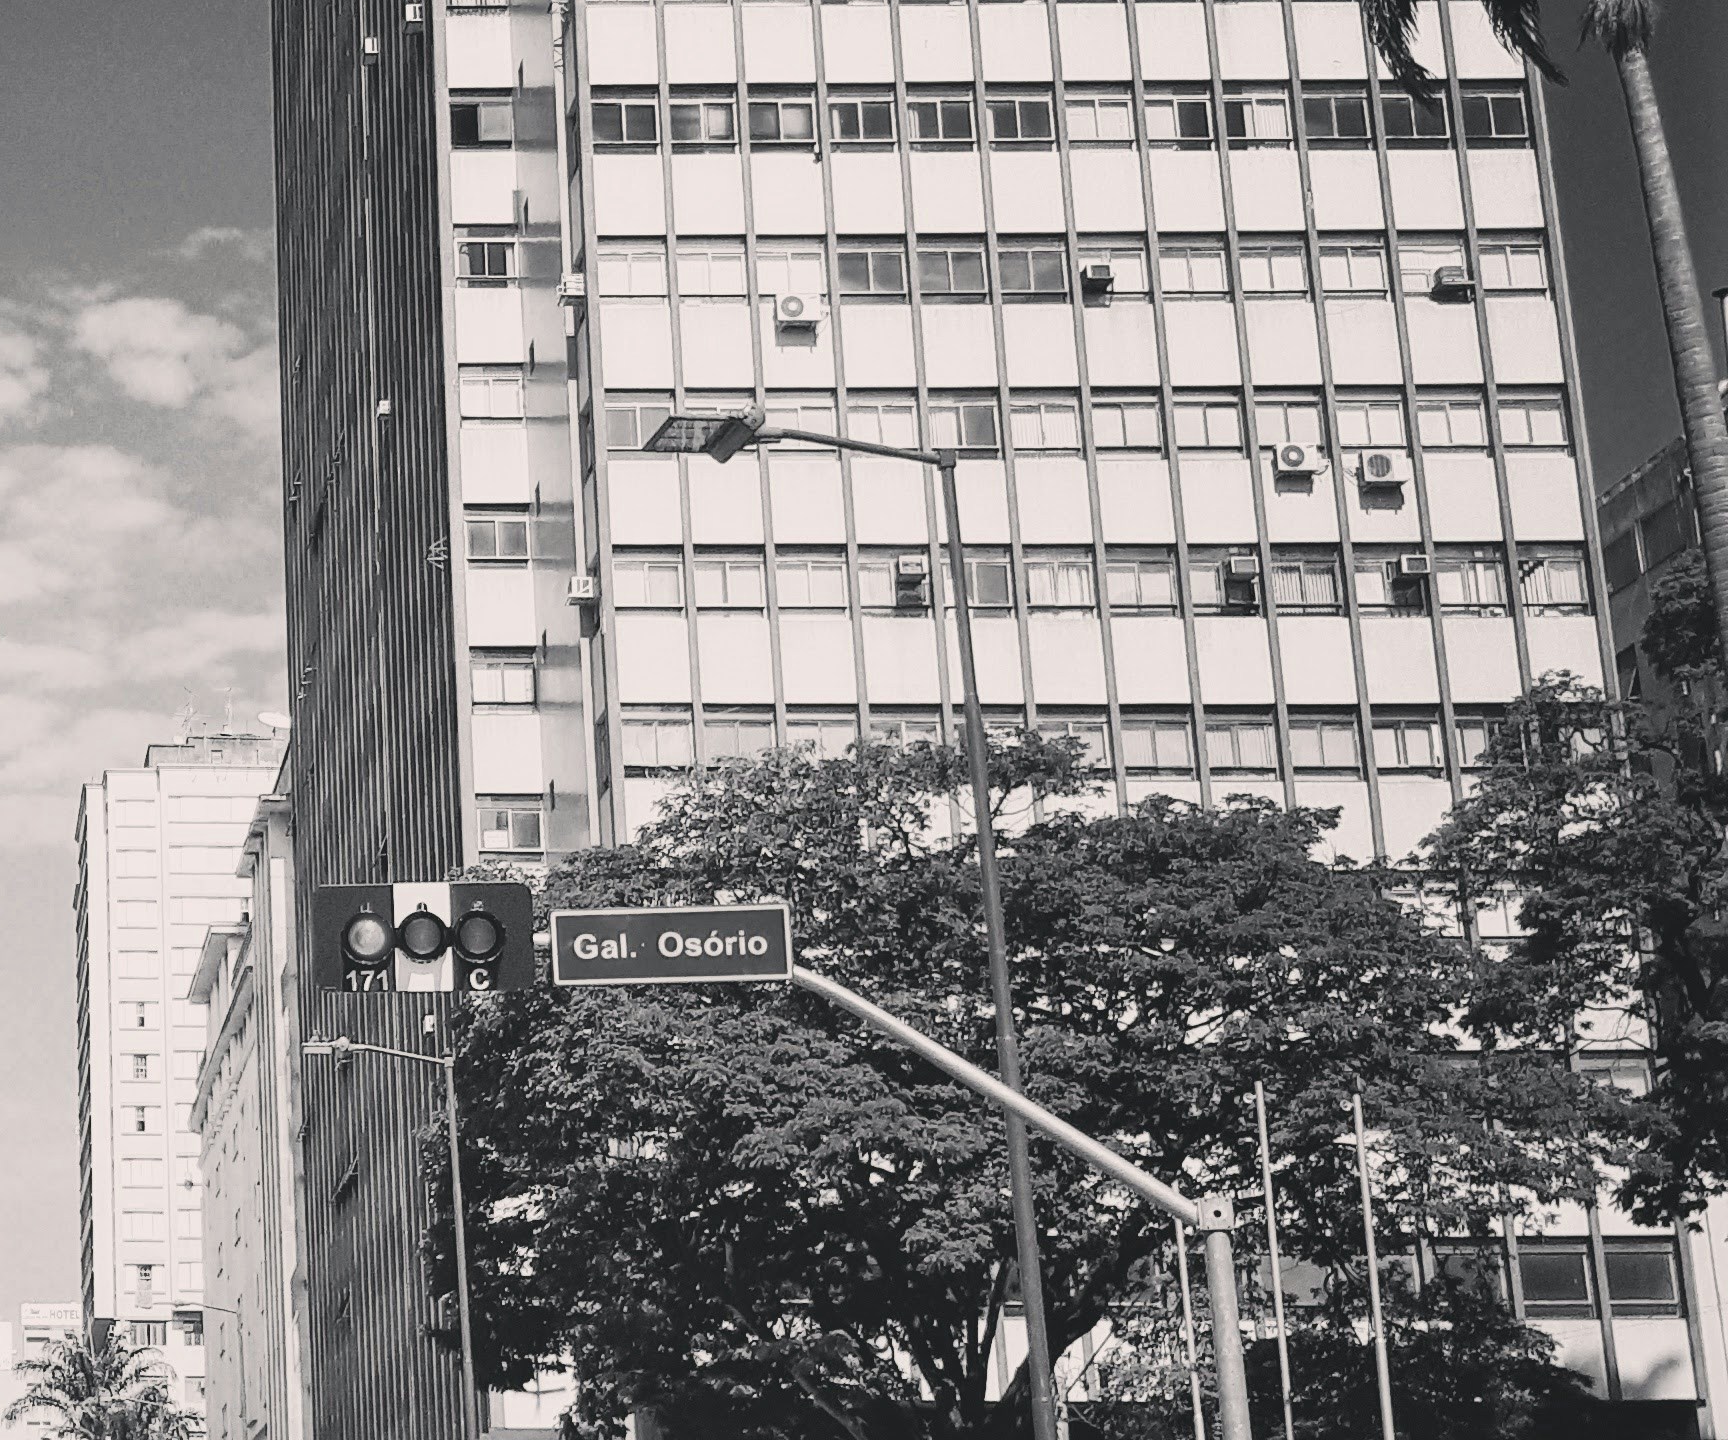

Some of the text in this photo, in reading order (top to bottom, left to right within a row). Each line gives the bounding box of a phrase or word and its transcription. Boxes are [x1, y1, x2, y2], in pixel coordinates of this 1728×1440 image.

[573, 929, 769, 960] Gal. Osório
[345, 969, 389, 992] 171
[469, 968, 490, 991] C
[49, 1309, 81, 1320] HOTEL
